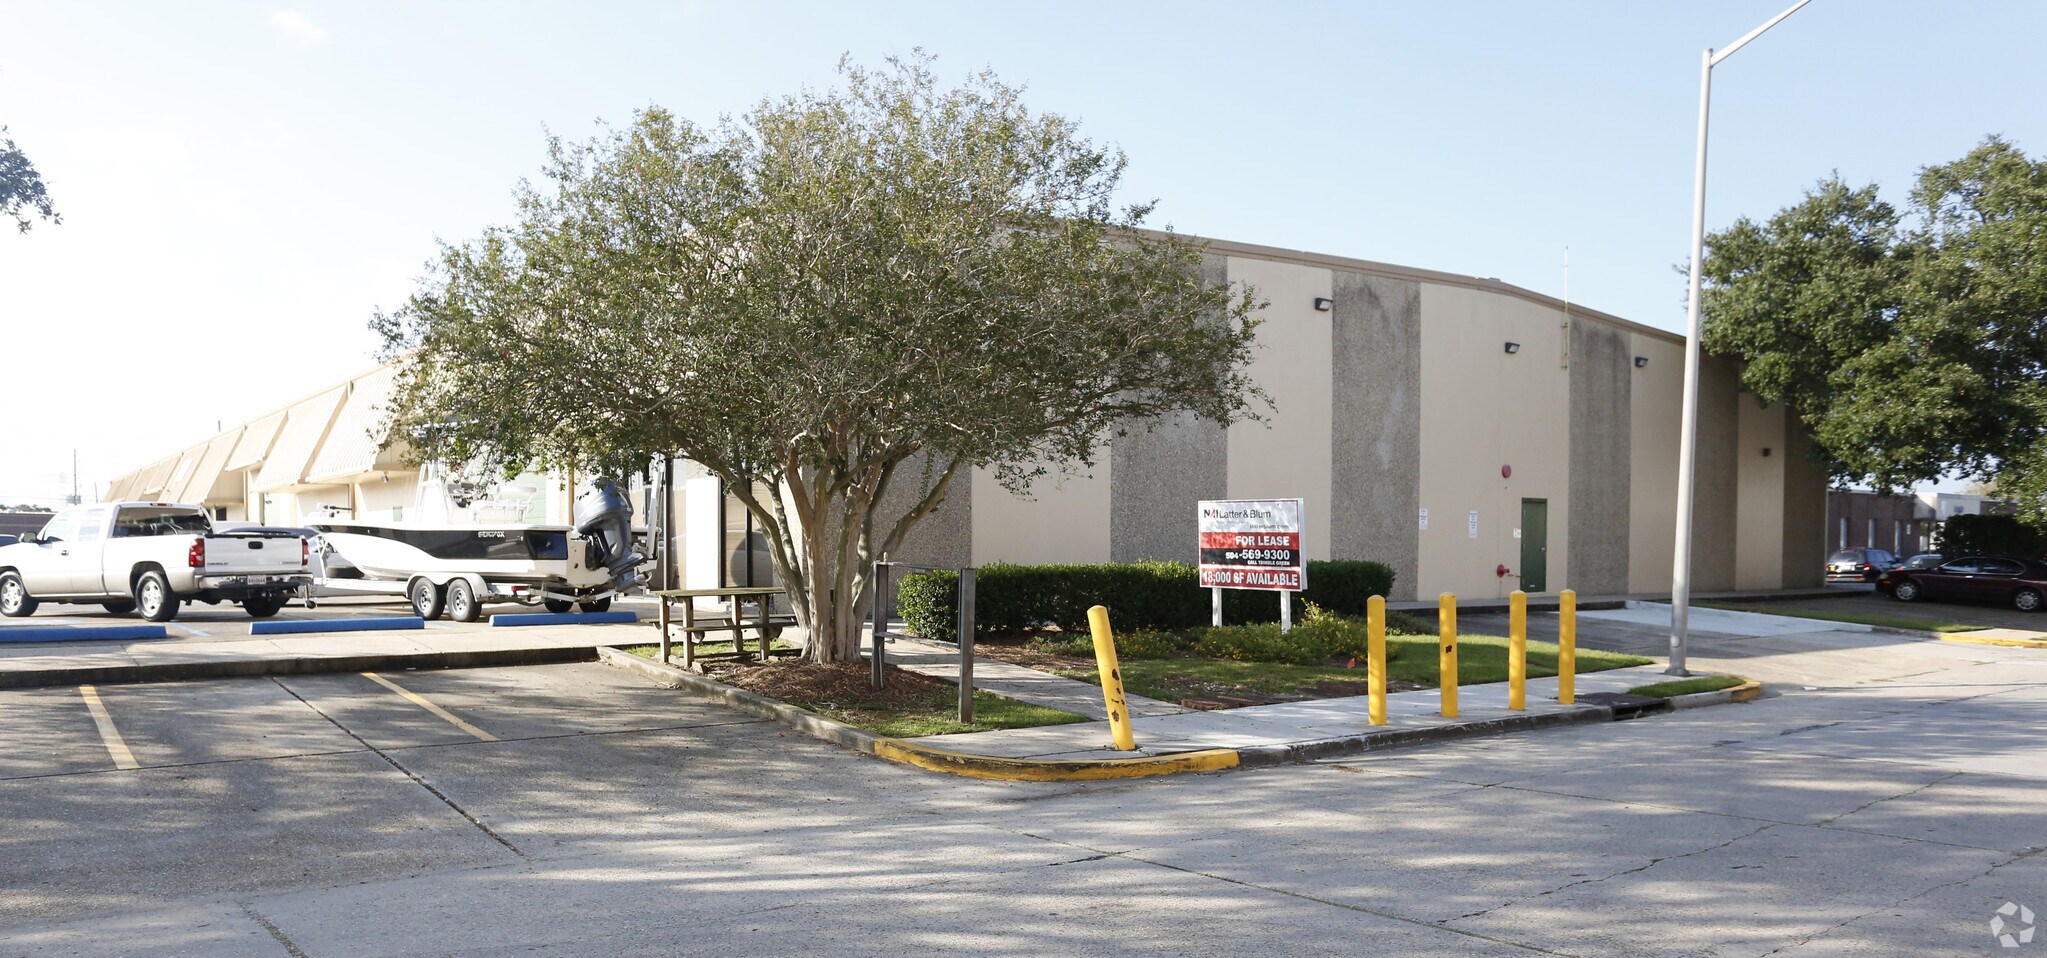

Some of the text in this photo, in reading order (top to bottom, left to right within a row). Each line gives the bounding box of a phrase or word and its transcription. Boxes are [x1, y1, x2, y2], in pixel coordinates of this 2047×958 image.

[1219, 509, 1243, 519] Latter
[1243, 510, 1249, 519] &
[1250, 509, 1272, 519] Blum
[1235, 536, 1290, 546] FOR LEASE
[1225, 549, 1290, 560] 504-569-9300
[1203, 572, 1298, 586] 18,000 SF AVAILABLE
